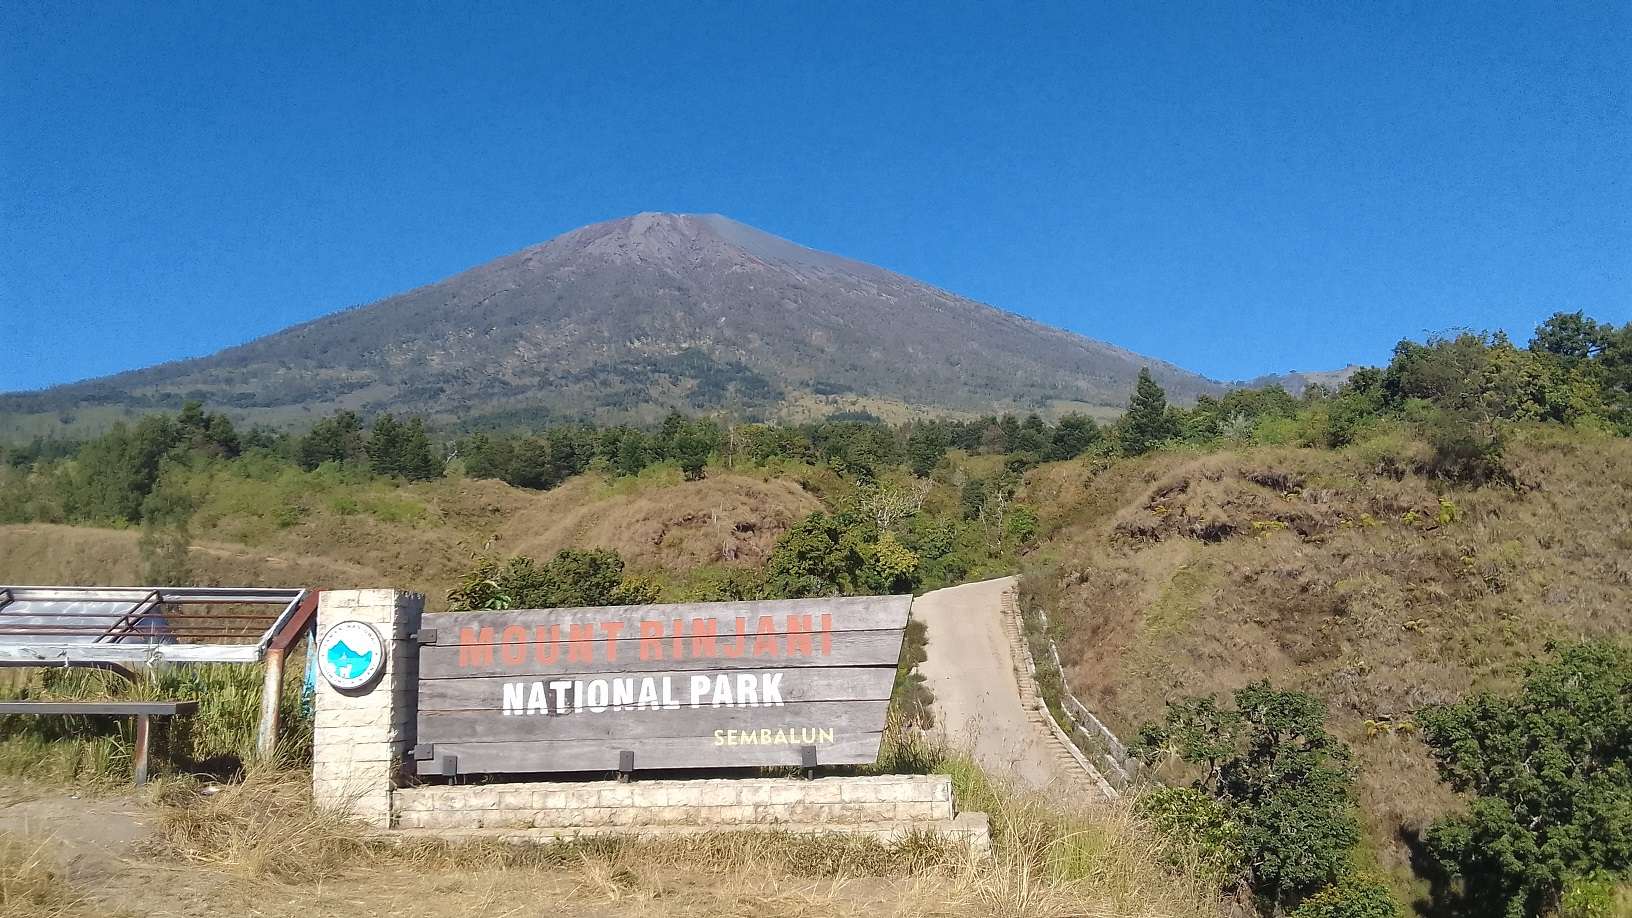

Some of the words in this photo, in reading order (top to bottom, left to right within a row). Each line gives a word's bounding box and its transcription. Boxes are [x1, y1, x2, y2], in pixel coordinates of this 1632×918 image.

[458, 621, 625, 668] MOUNT
[639, 613, 834, 661] RINJANI
[502, 675, 680, 716] NATIONAL
[689, 672, 785, 708] PARK
[713, 727, 835, 747] SEMBALUN
